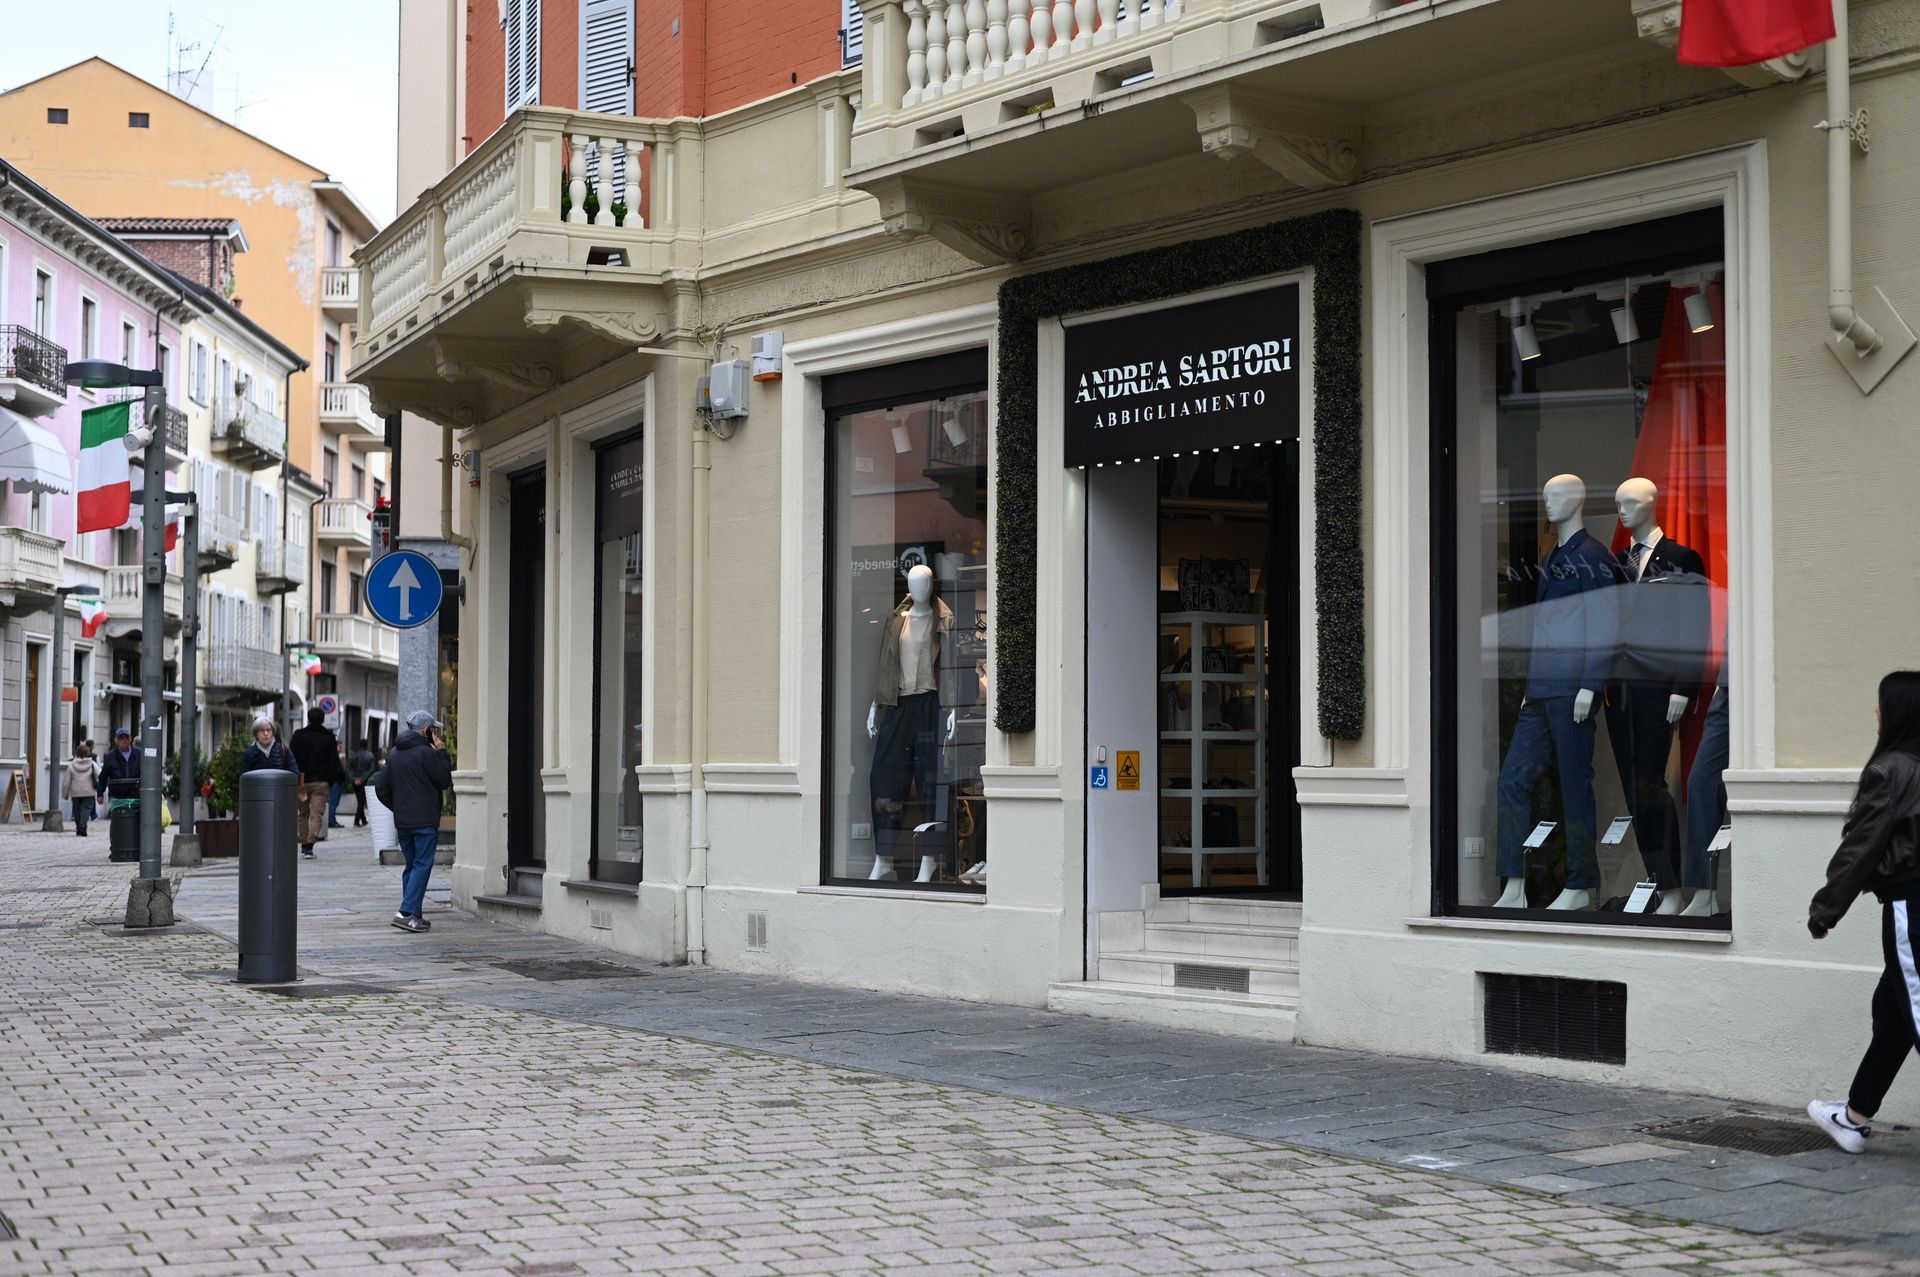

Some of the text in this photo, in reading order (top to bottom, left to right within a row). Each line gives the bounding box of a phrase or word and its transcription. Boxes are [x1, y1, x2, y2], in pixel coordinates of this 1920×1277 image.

[1075, 338, 1292, 404] ANDREA SARTORI
[1093, 389, 1266, 429] ABBIGLIAMENTO
